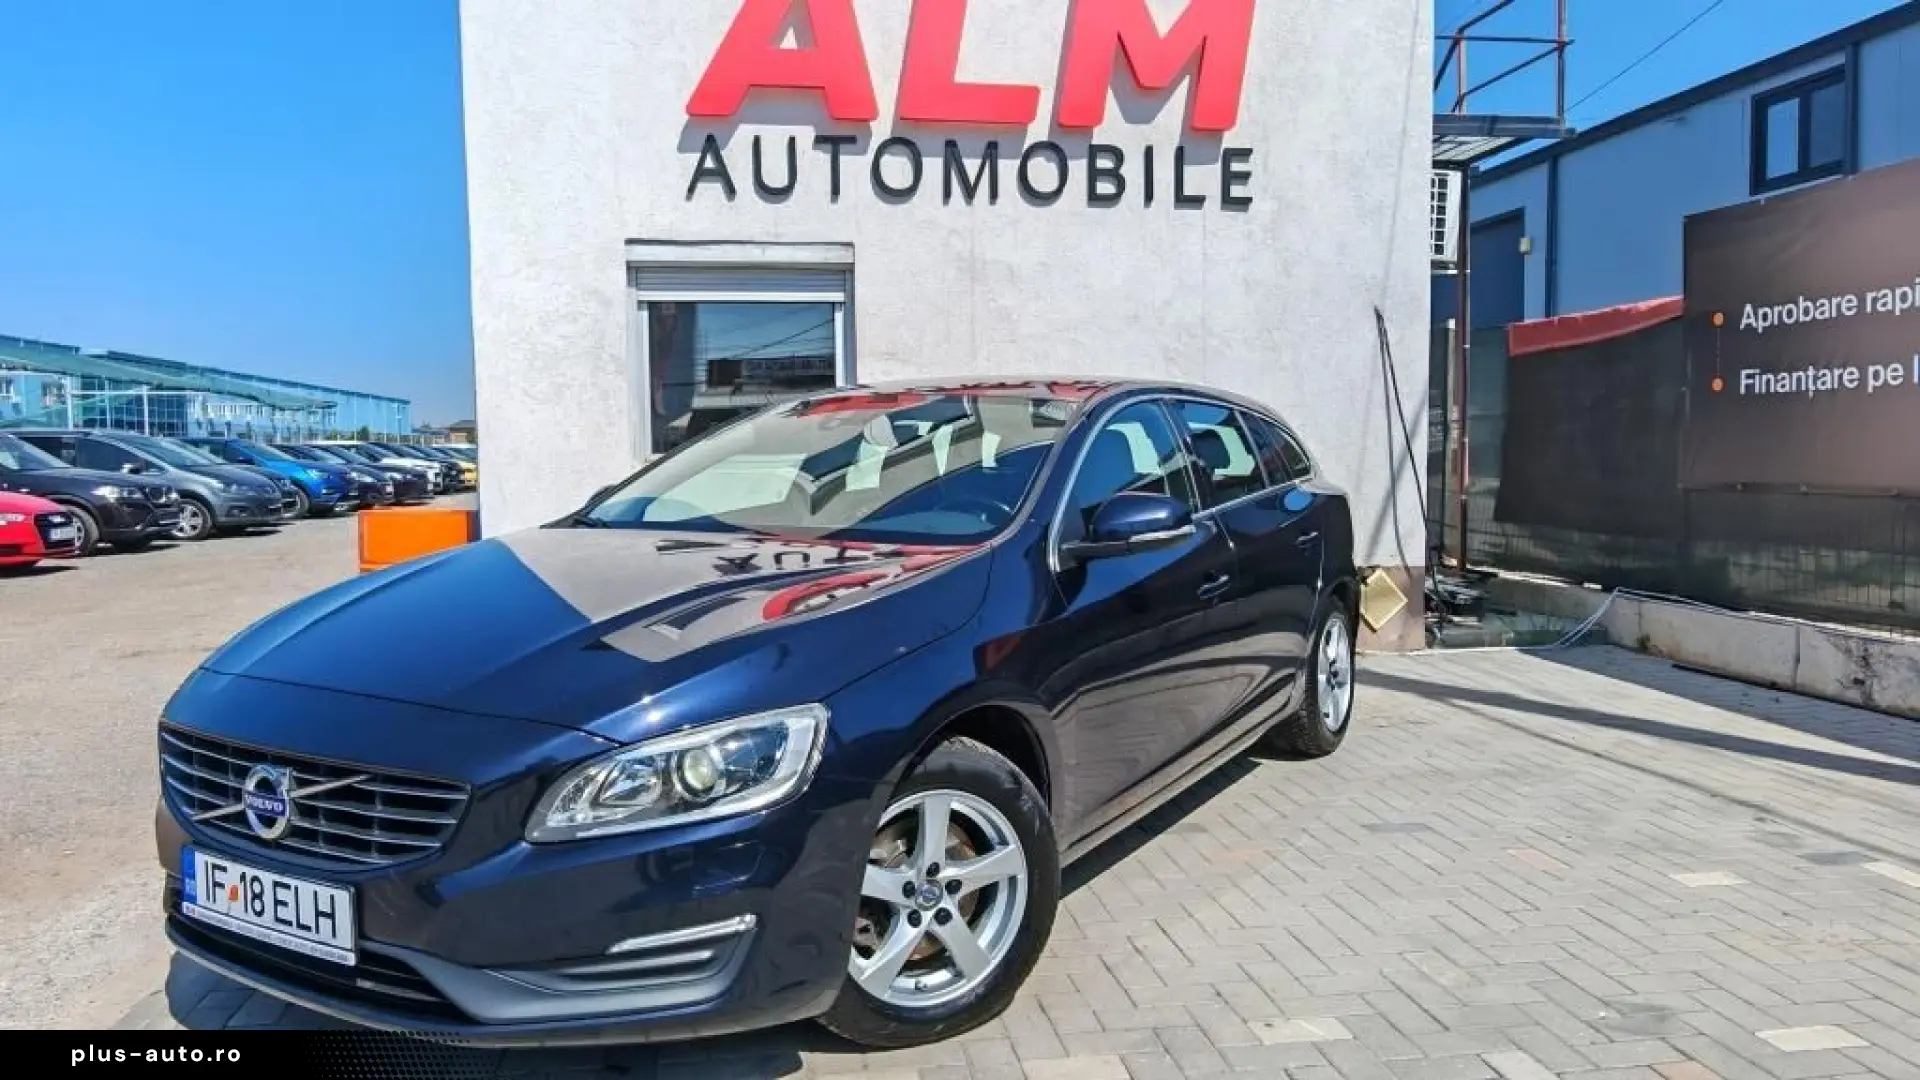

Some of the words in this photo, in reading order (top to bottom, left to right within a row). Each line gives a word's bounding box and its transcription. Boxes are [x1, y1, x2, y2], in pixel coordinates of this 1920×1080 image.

[685, 0, 1257, 131] ALM
[686, 133, 1254, 209] AUTOMOBILE
[1739, 295, 1858, 334] Aprobare
[1739, 365, 1860, 399] Finanțare
[1866, 362, 1905, 393] pe
[204, 860, 228, 904] IF
[239, 871, 265, 918] 18
[271, 879, 337, 940] ELH
